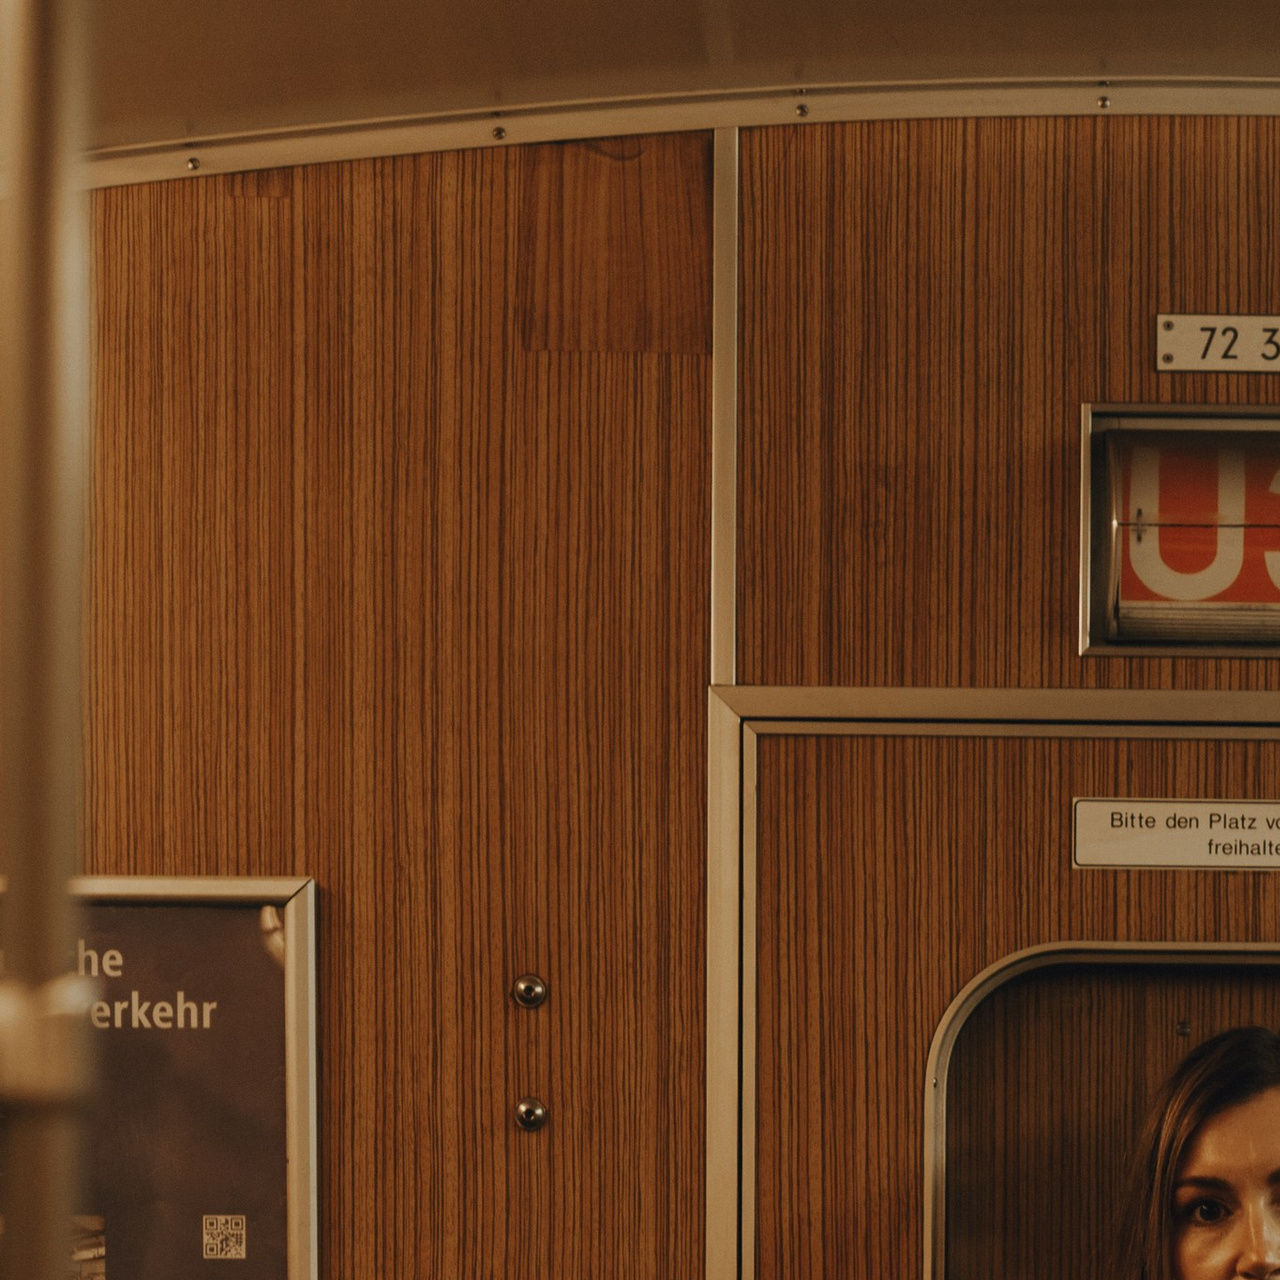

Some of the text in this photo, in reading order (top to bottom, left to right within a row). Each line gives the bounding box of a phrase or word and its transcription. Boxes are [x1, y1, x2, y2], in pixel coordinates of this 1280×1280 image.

[1199, 326, 1239, 360] 72
[1110, 811, 1156, 829] Bitte
[1165, 812, 1199, 829] den
[1208, 813, 1257, 830] Platz
[77, 938, 124, 977] he
[90, 990, 217, 1029] erkehr
